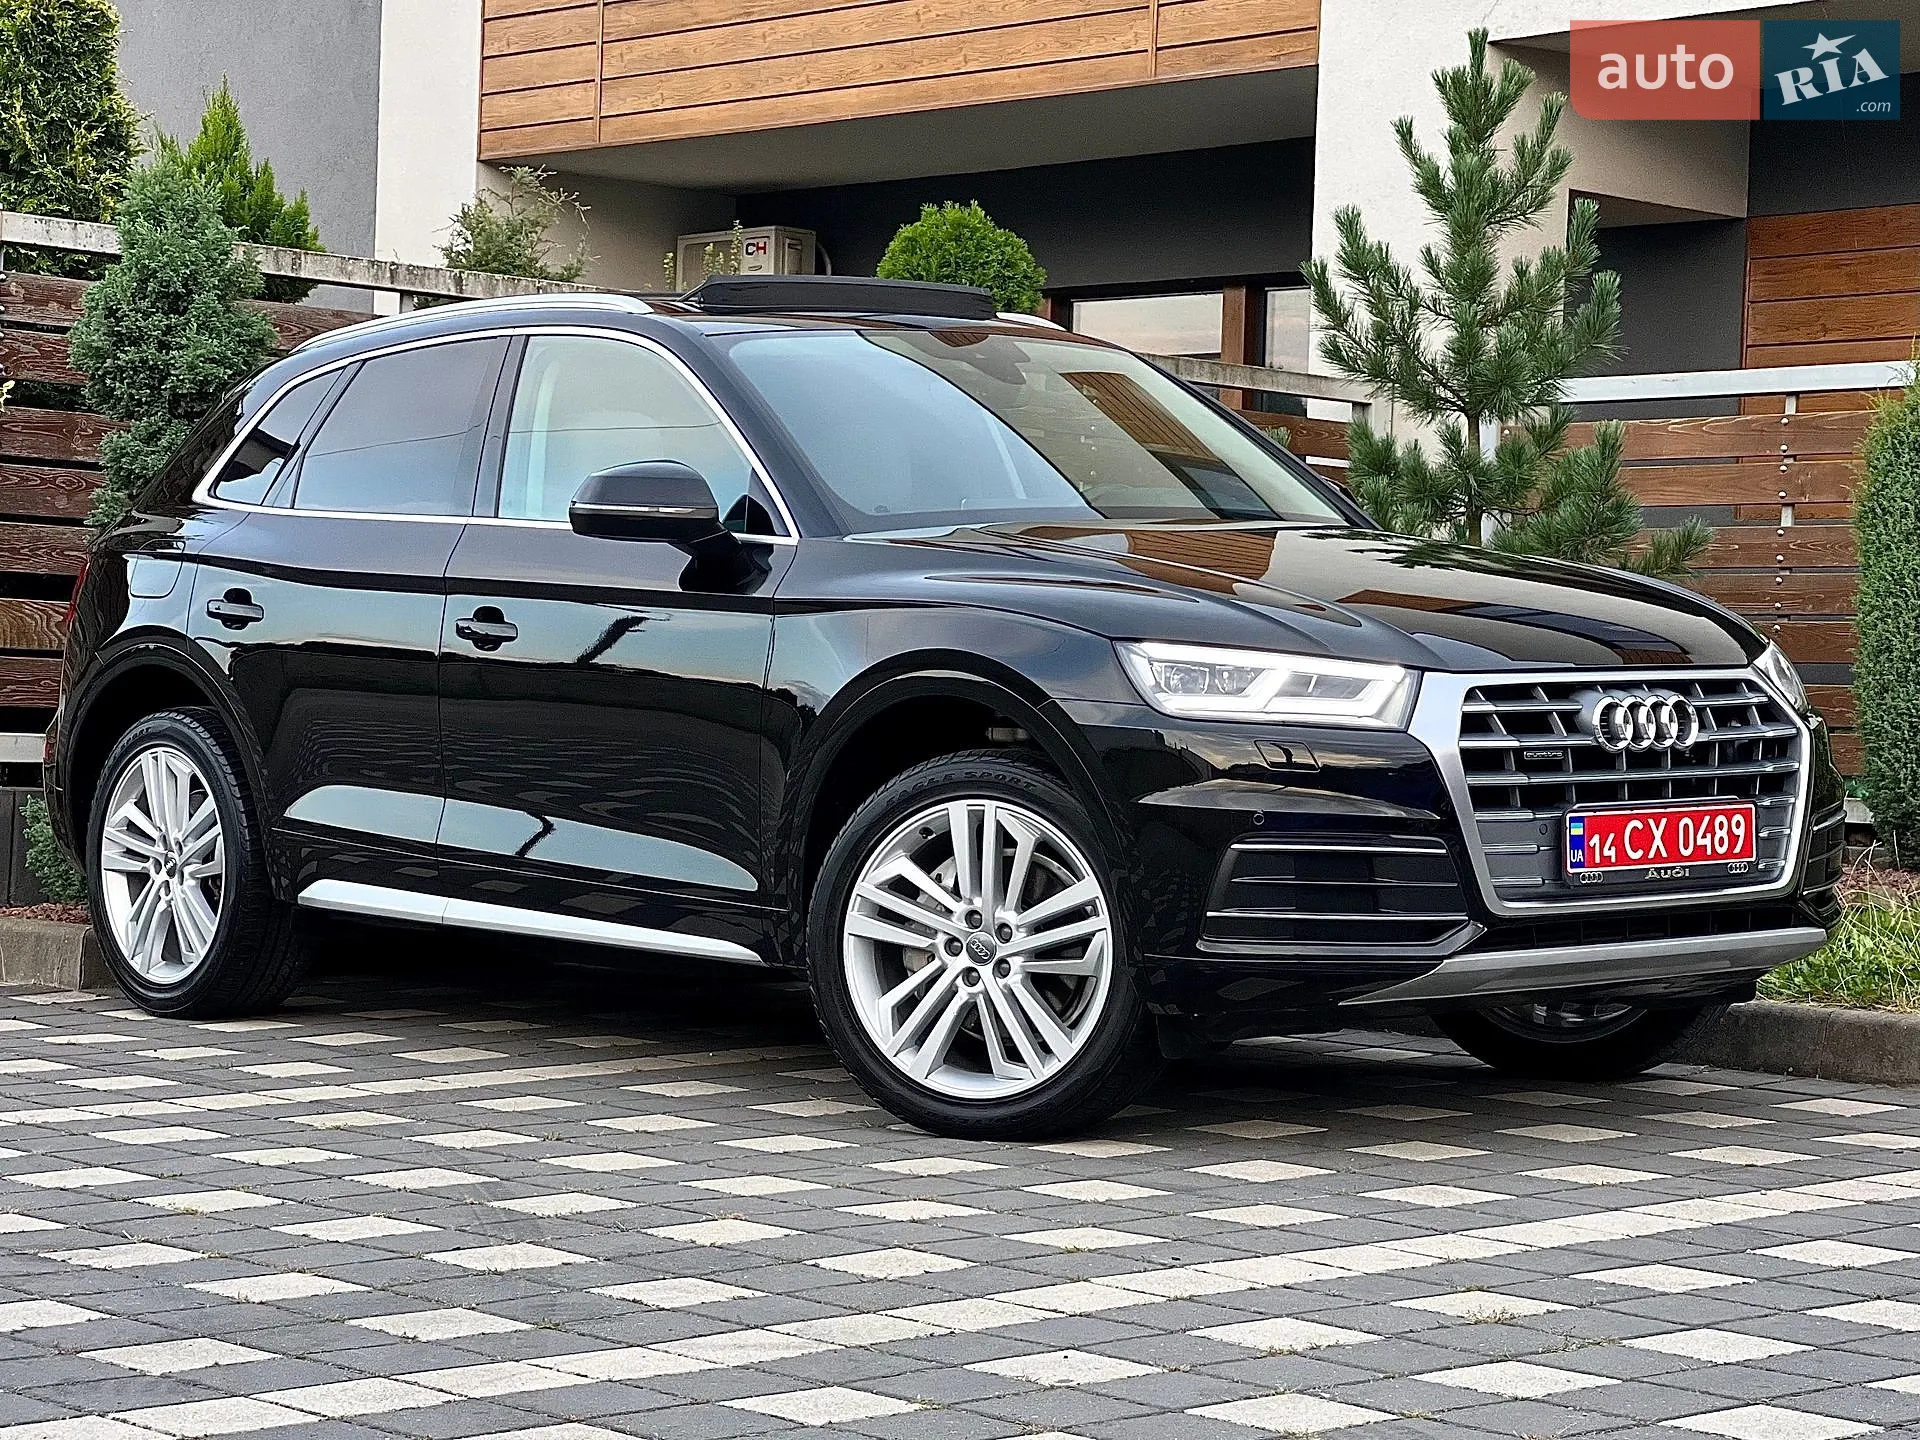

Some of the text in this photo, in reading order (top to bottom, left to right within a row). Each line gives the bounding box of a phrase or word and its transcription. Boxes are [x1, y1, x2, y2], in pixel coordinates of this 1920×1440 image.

[745, 241, 767, 256] CH
[964, 770, 1038, 792] SPORT
[1588, 813, 1746, 863] 14 CX 0489
[1570, 849, 1584, 863] UA
